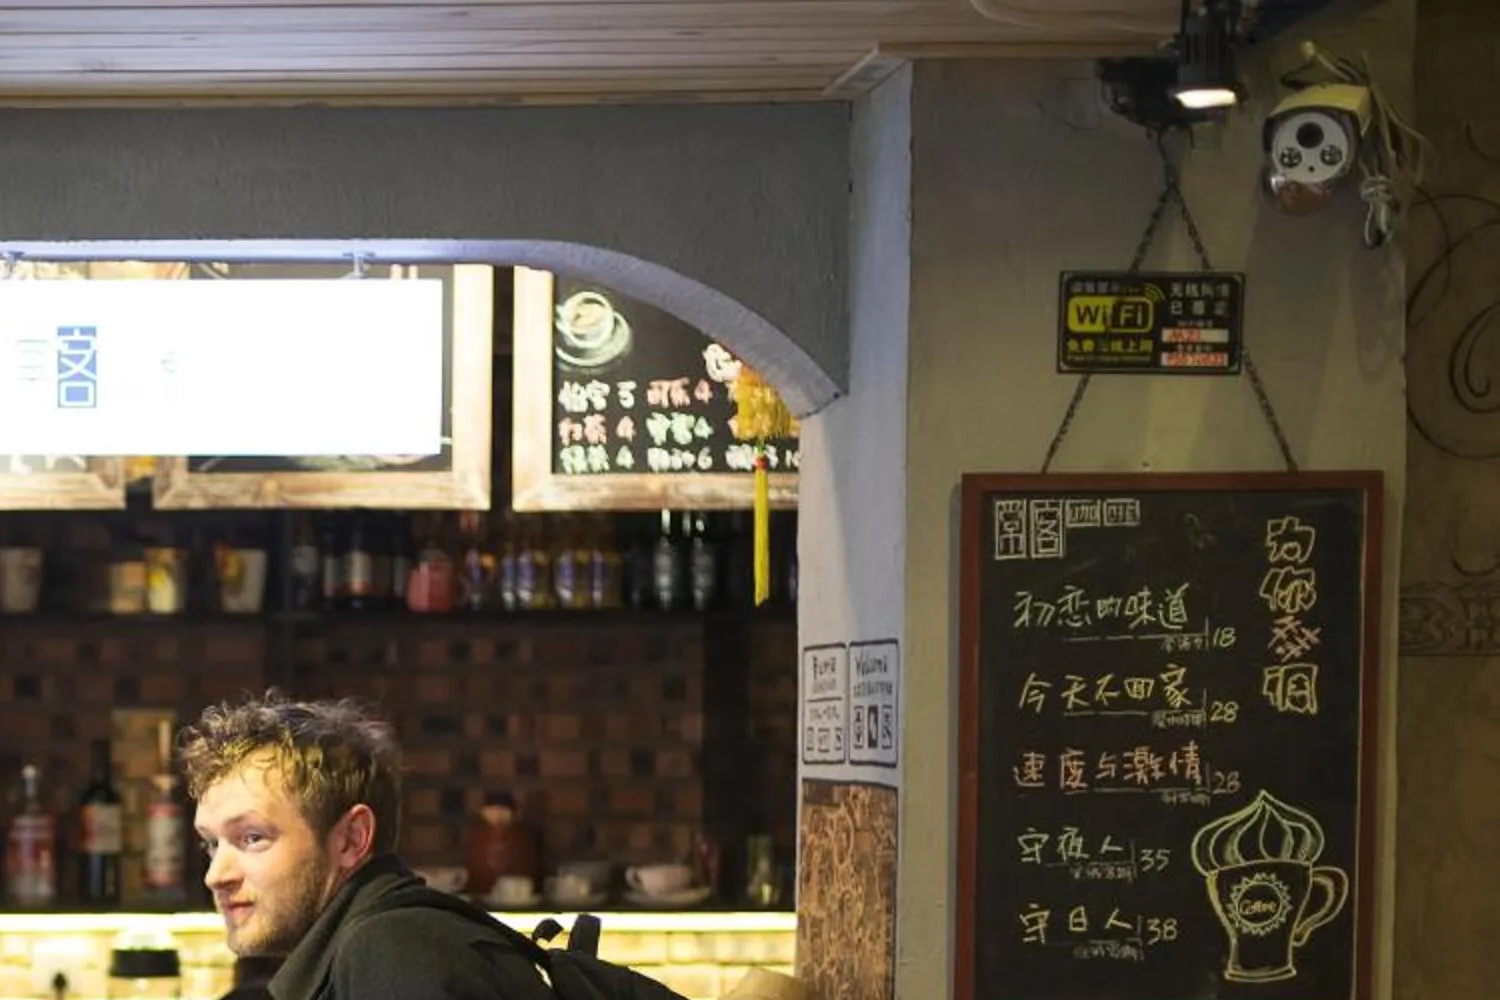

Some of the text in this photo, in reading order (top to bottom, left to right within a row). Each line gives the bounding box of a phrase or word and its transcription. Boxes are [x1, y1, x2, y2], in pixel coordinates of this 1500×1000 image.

[1212, 627, 1237, 648] 18
[1210, 701, 1240, 723] 28
[1013, 739, 1241, 795] 速度与激情 28
[1140, 849, 1171, 872] 35
[1147, 917, 1179, 945] 38
